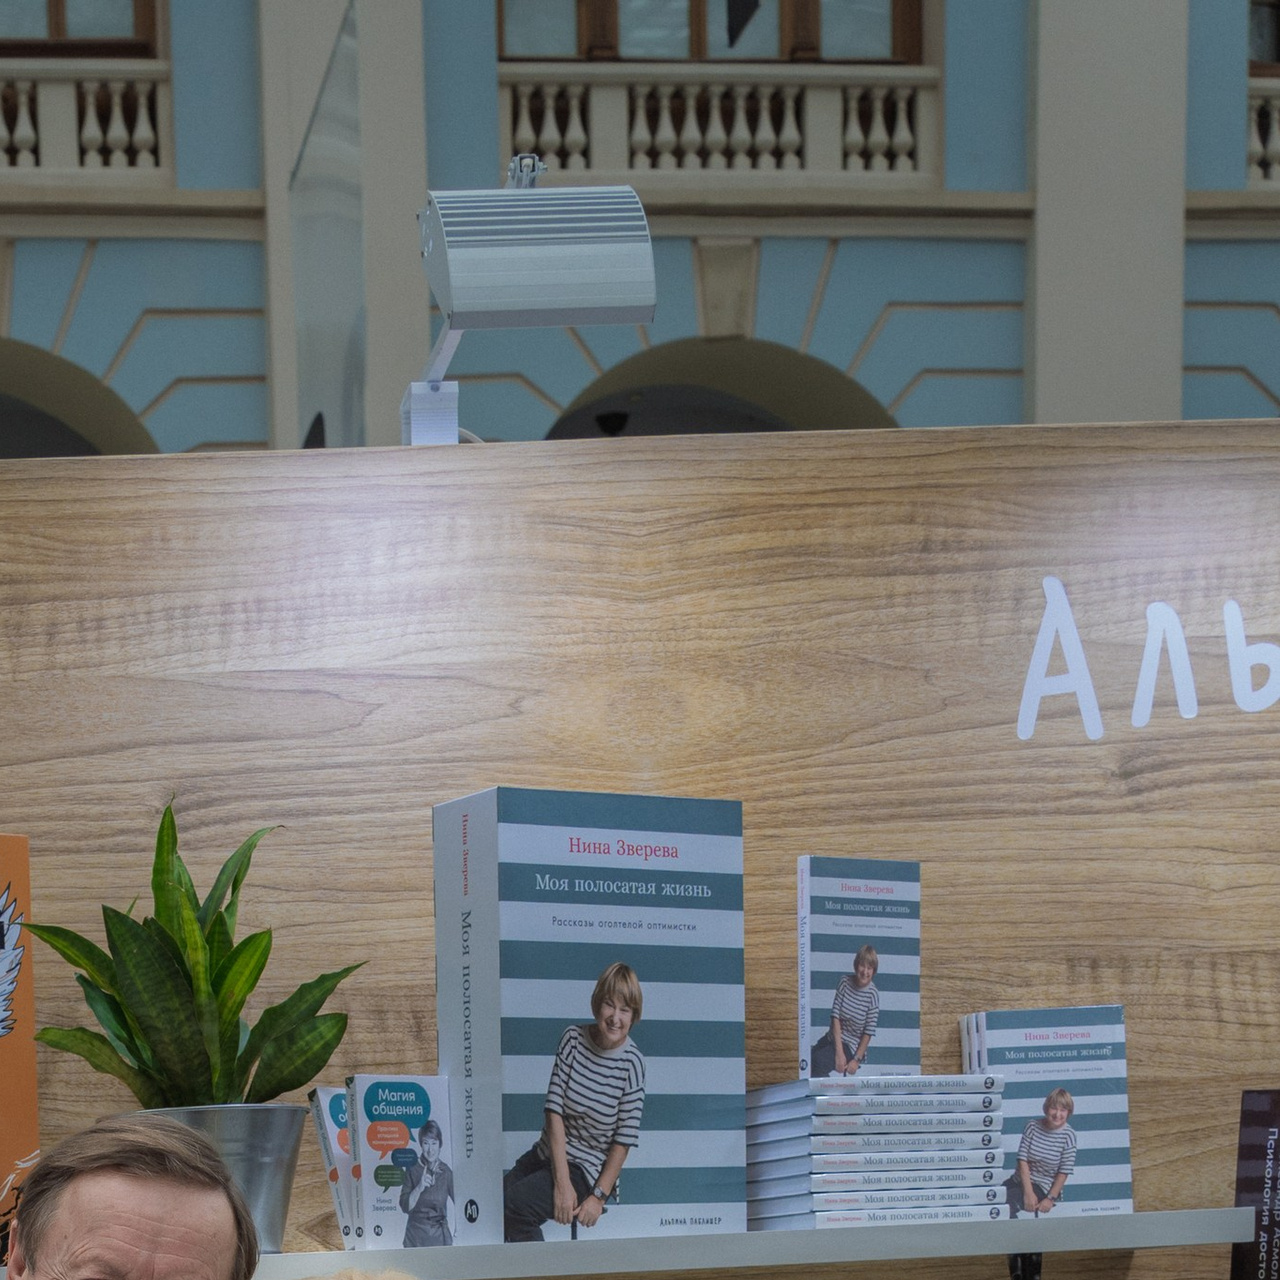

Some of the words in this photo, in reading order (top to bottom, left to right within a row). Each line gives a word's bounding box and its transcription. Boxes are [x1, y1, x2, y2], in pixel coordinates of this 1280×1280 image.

[569, 837, 611, 854] Нина
[616, 840, 679, 861] Зверева
[535, 874, 569, 890] Моя
[574, 878, 656, 896] полосатая
[661, 884, 712, 898] жизнь
[840, 883, 862, 892] Нина
[864, 884, 894, 894] Зверева
[825, 901, 842, 910] Моя
[843, 903, 883, 912] полосатая
[884, 905, 910, 914] жизнь
[552, 916, 594, 928] Рассказы
[598, 920, 643, 930] оголтелой
[647, 922, 697, 931] оптимистки
[461, 910, 472, 956] Моя
[462, 965, 473, 1078] полосатая
[1024, 1032, 1050, 1041] Нина
[1053, 1031, 1090, 1042] Зверева
[1005, 1050, 1025, 1060] Моя
[1028, 1050, 1078, 1059] полосатая
[861, 1080, 880, 1089] Моя
[883, 1079, 934, 1089] полосатая
[936, 1078, 967, 1087] жизнь
[378, 1088, 416, 1102] Магия
[865, 1100, 884, 1108] Моя
[887, 1098, 934, 1108] полосатая
[936, 1097, 966, 1106] жизнь
[372, 1102, 424, 1116] общения
[464, 1088, 474, 1159] жизнь
[862, 1118, 882, 1127] Моя
[885, 1118, 934, 1126] полосатая
[936, 1116, 966, 1126] жизнь
[862, 1138, 881, 1146] Моя
[884, 1137, 932, 1146] полосатая
[934, 1136, 966, 1146] жизнь
[864, 1156, 883, 1166] Моя
[886, 1156, 934, 1165] полосатая
[938, 1154, 968, 1164] жизнь
[862, 1176, 882, 1184] Моя
[884, 1175, 934, 1184] полосатая
[936, 1174, 966, 1183] жизнь
[1262, 1128, 1278, 1226] Психология
[864, 1194, 884, 1204] Моя
[888, 1194, 936, 1203] полосатая
[938, 1193, 970, 1202] жизнь
[372, 1204, 397, 1212] Зверева
[867, 1213, 886, 1222] Моя
[890, 1211, 938, 1221] полосатая
[942, 1210, 972, 1220] жизнь
